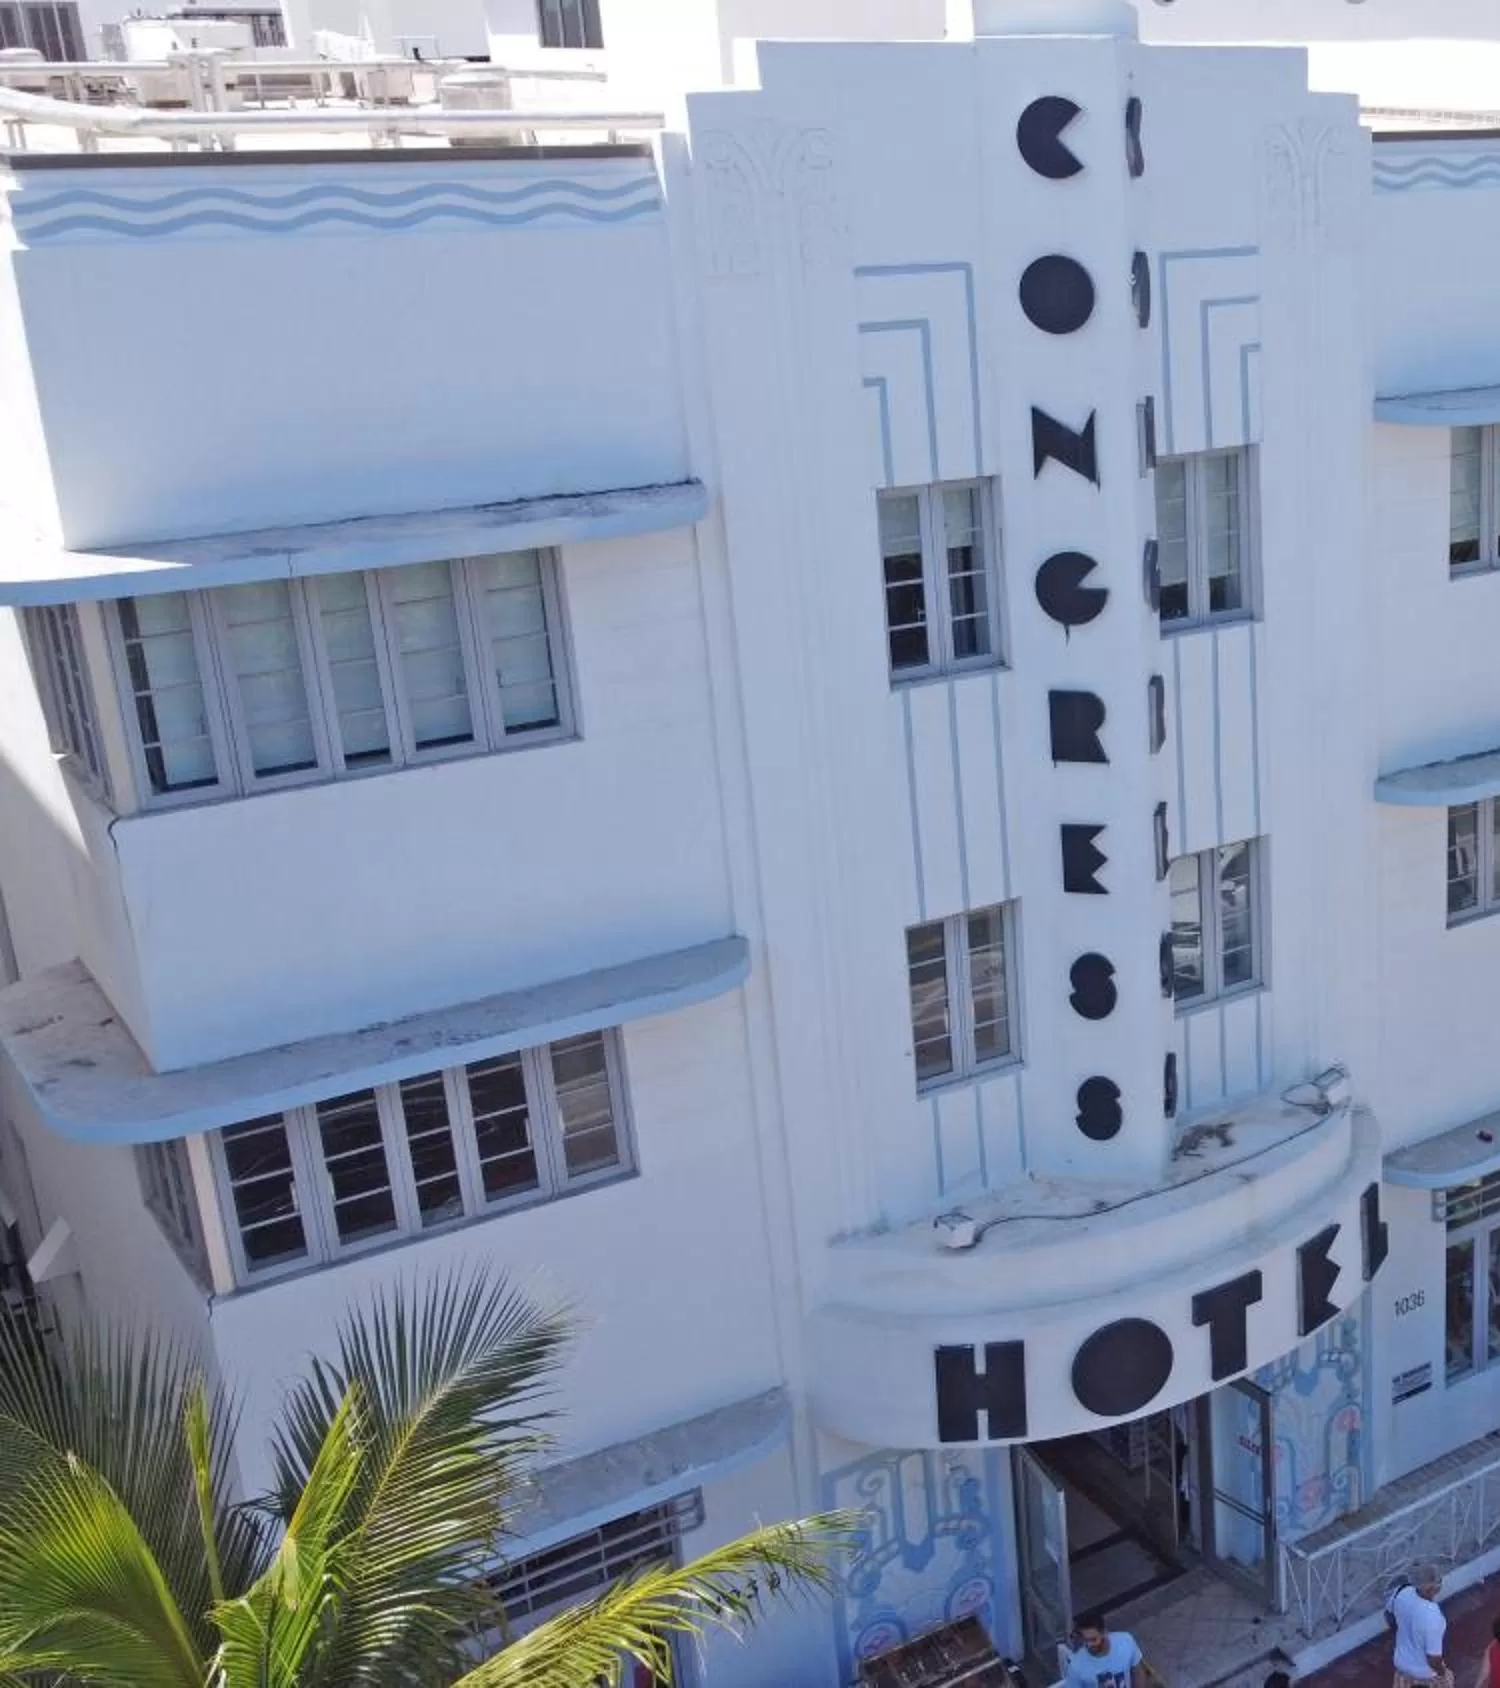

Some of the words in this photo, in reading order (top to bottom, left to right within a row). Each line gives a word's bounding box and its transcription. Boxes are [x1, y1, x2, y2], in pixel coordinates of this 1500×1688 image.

[1017, 96, 1123, 1140] CONGRESS
[935, 1182, 1388, 1442] HOTEL
[1394, 1290, 1425, 1317] 1036
